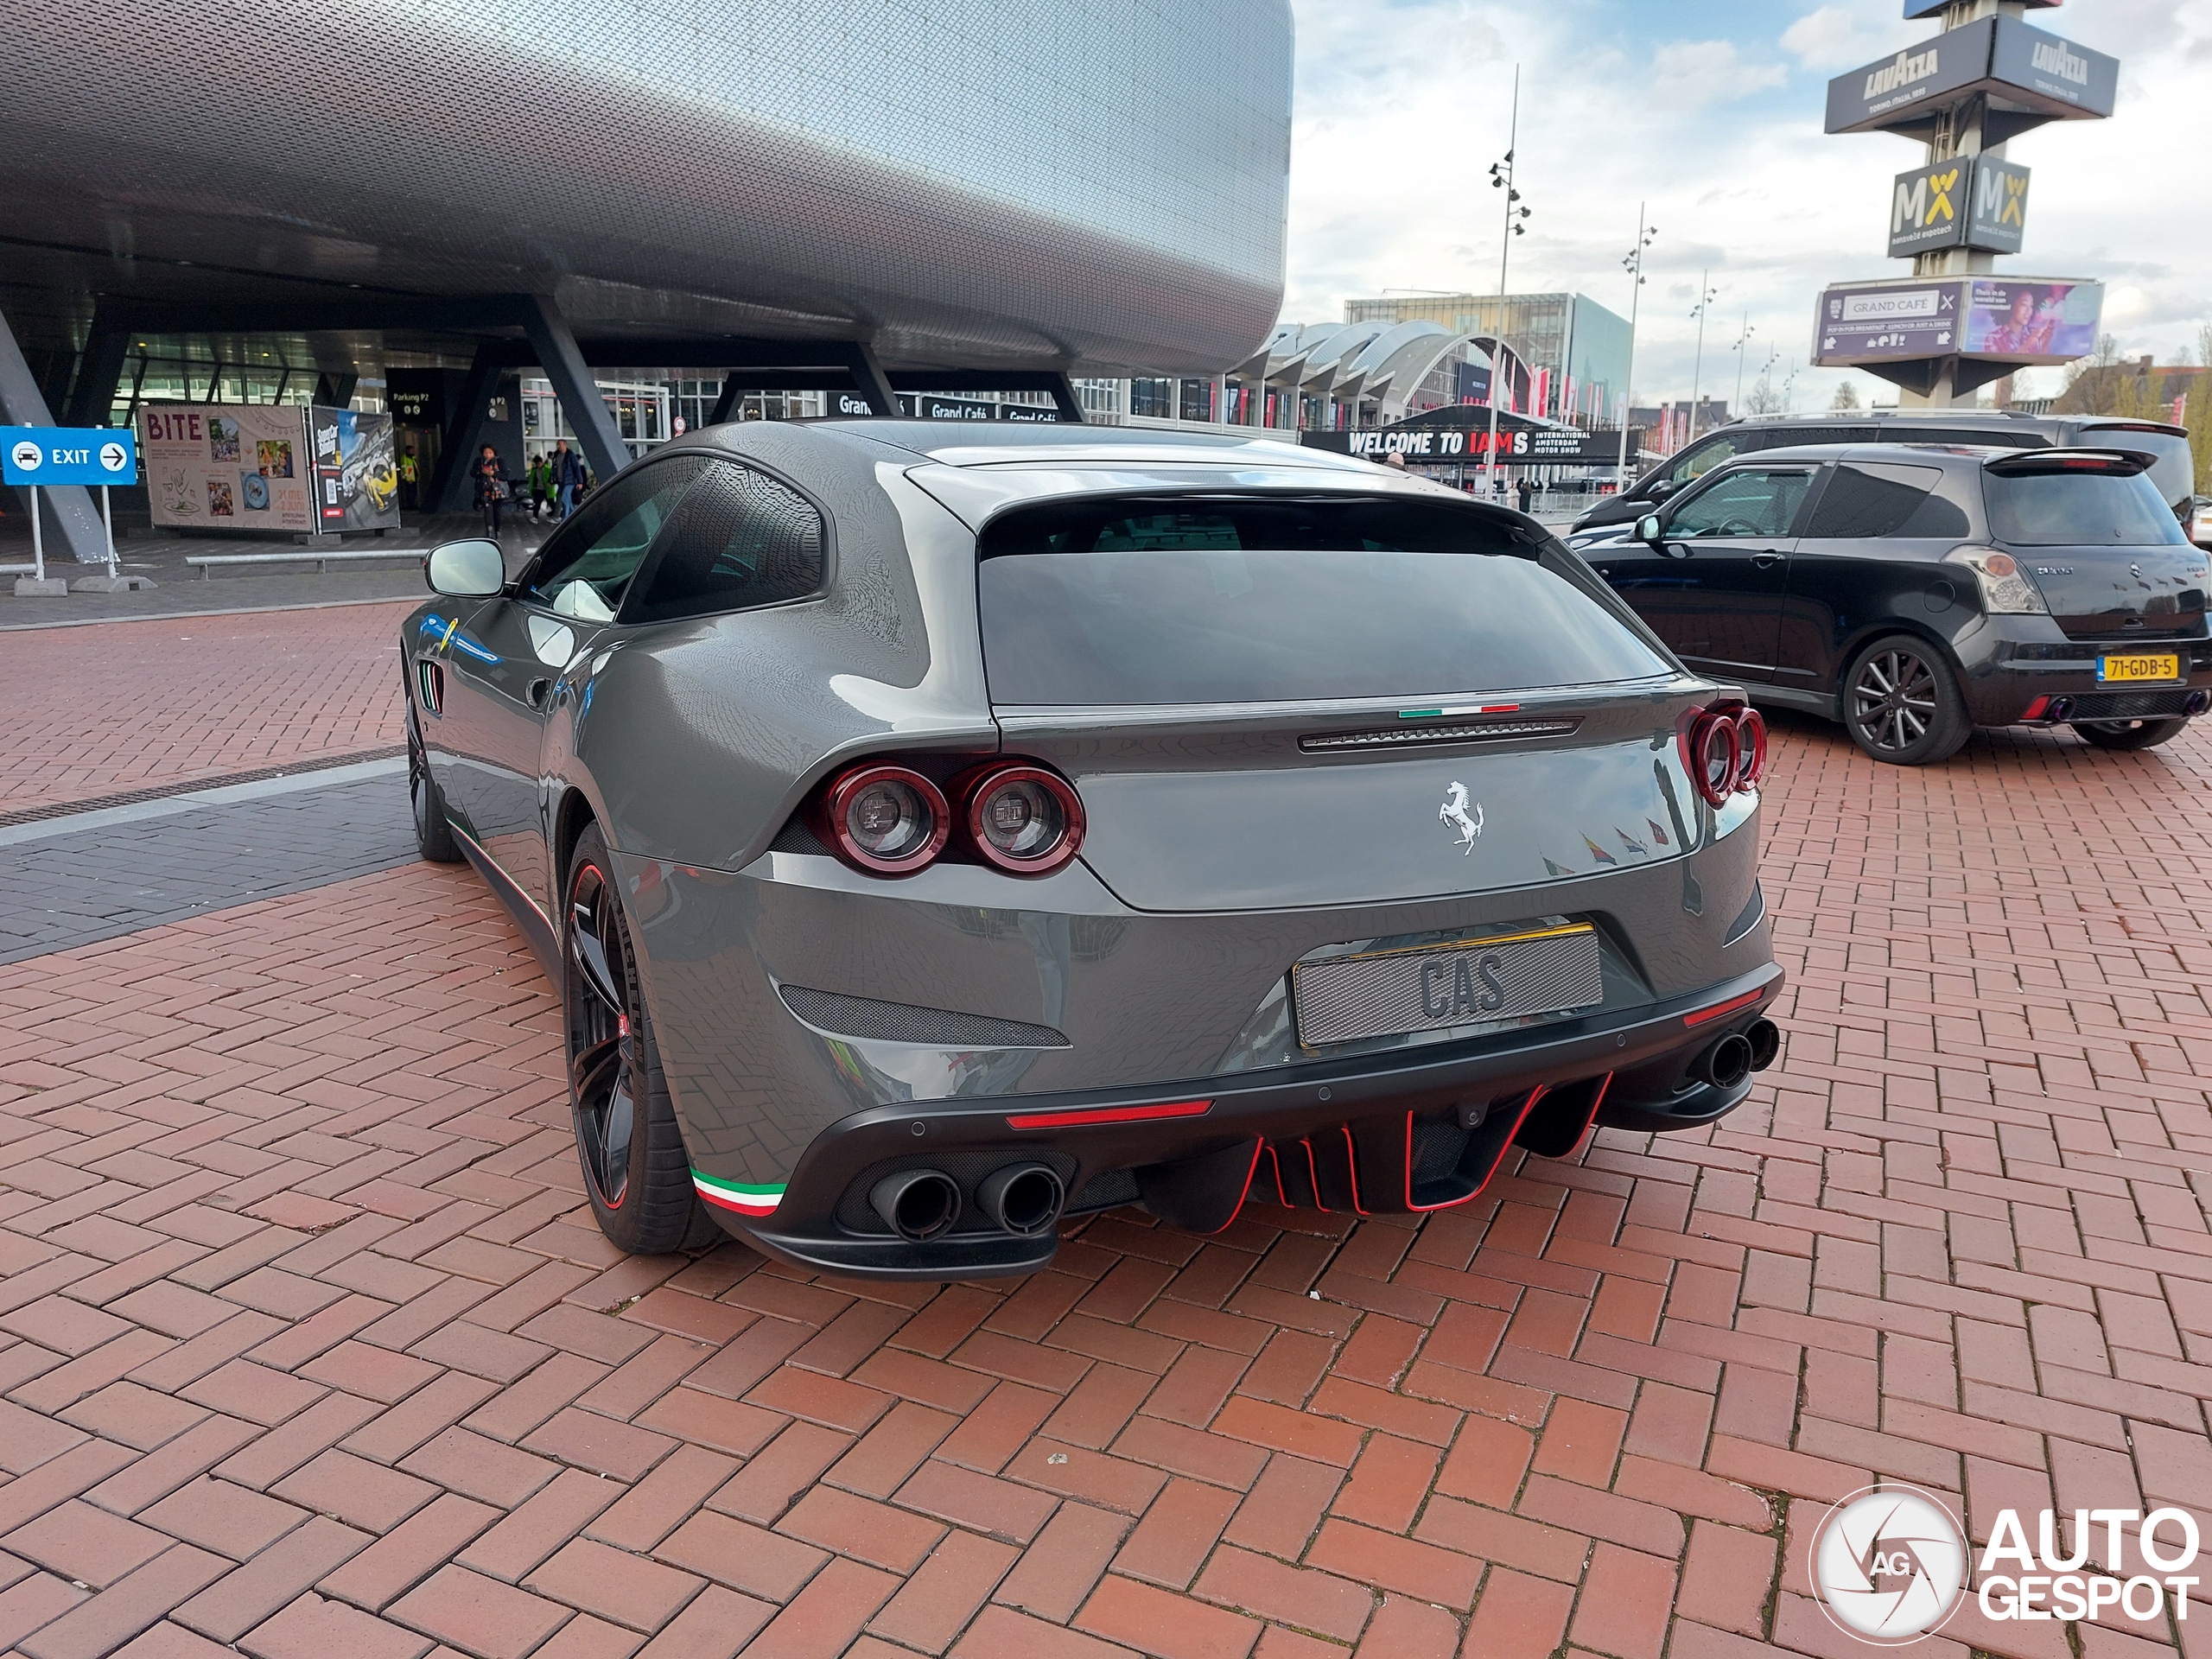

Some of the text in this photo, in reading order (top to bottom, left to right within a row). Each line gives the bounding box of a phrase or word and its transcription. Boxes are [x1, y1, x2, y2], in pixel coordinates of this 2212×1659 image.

[2031, 40, 2088, 86] LAVAZZA
[1864, 48, 1938, 100] LAVAZZA
[1893, 168, 1959, 233] MX
[1977, 167, 2026, 228] MX
[1853, 301, 1896, 314] GRAND
[1897, 297, 1929, 311] CAFÉ
[393, 392, 429, 404] Parking P2
[496, 397, 505, 405] P2
[931, 403, 987, 419] Grand Café
[147, 414, 202, 441] BITE
[1349, 432, 1529, 454] WELCOME TO IAMS
[52, 448, 90, 464] EXIT
[288, 489, 304, 499] MEI
[280, 500, 286, 512] 2
[288, 501, 305, 512] JUNI
[2110, 658, 2172, 677] 71-GDB-5
[618, 911, 645, 1065] MICHELIN
[1420, 953, 1505, 1019] CAS
